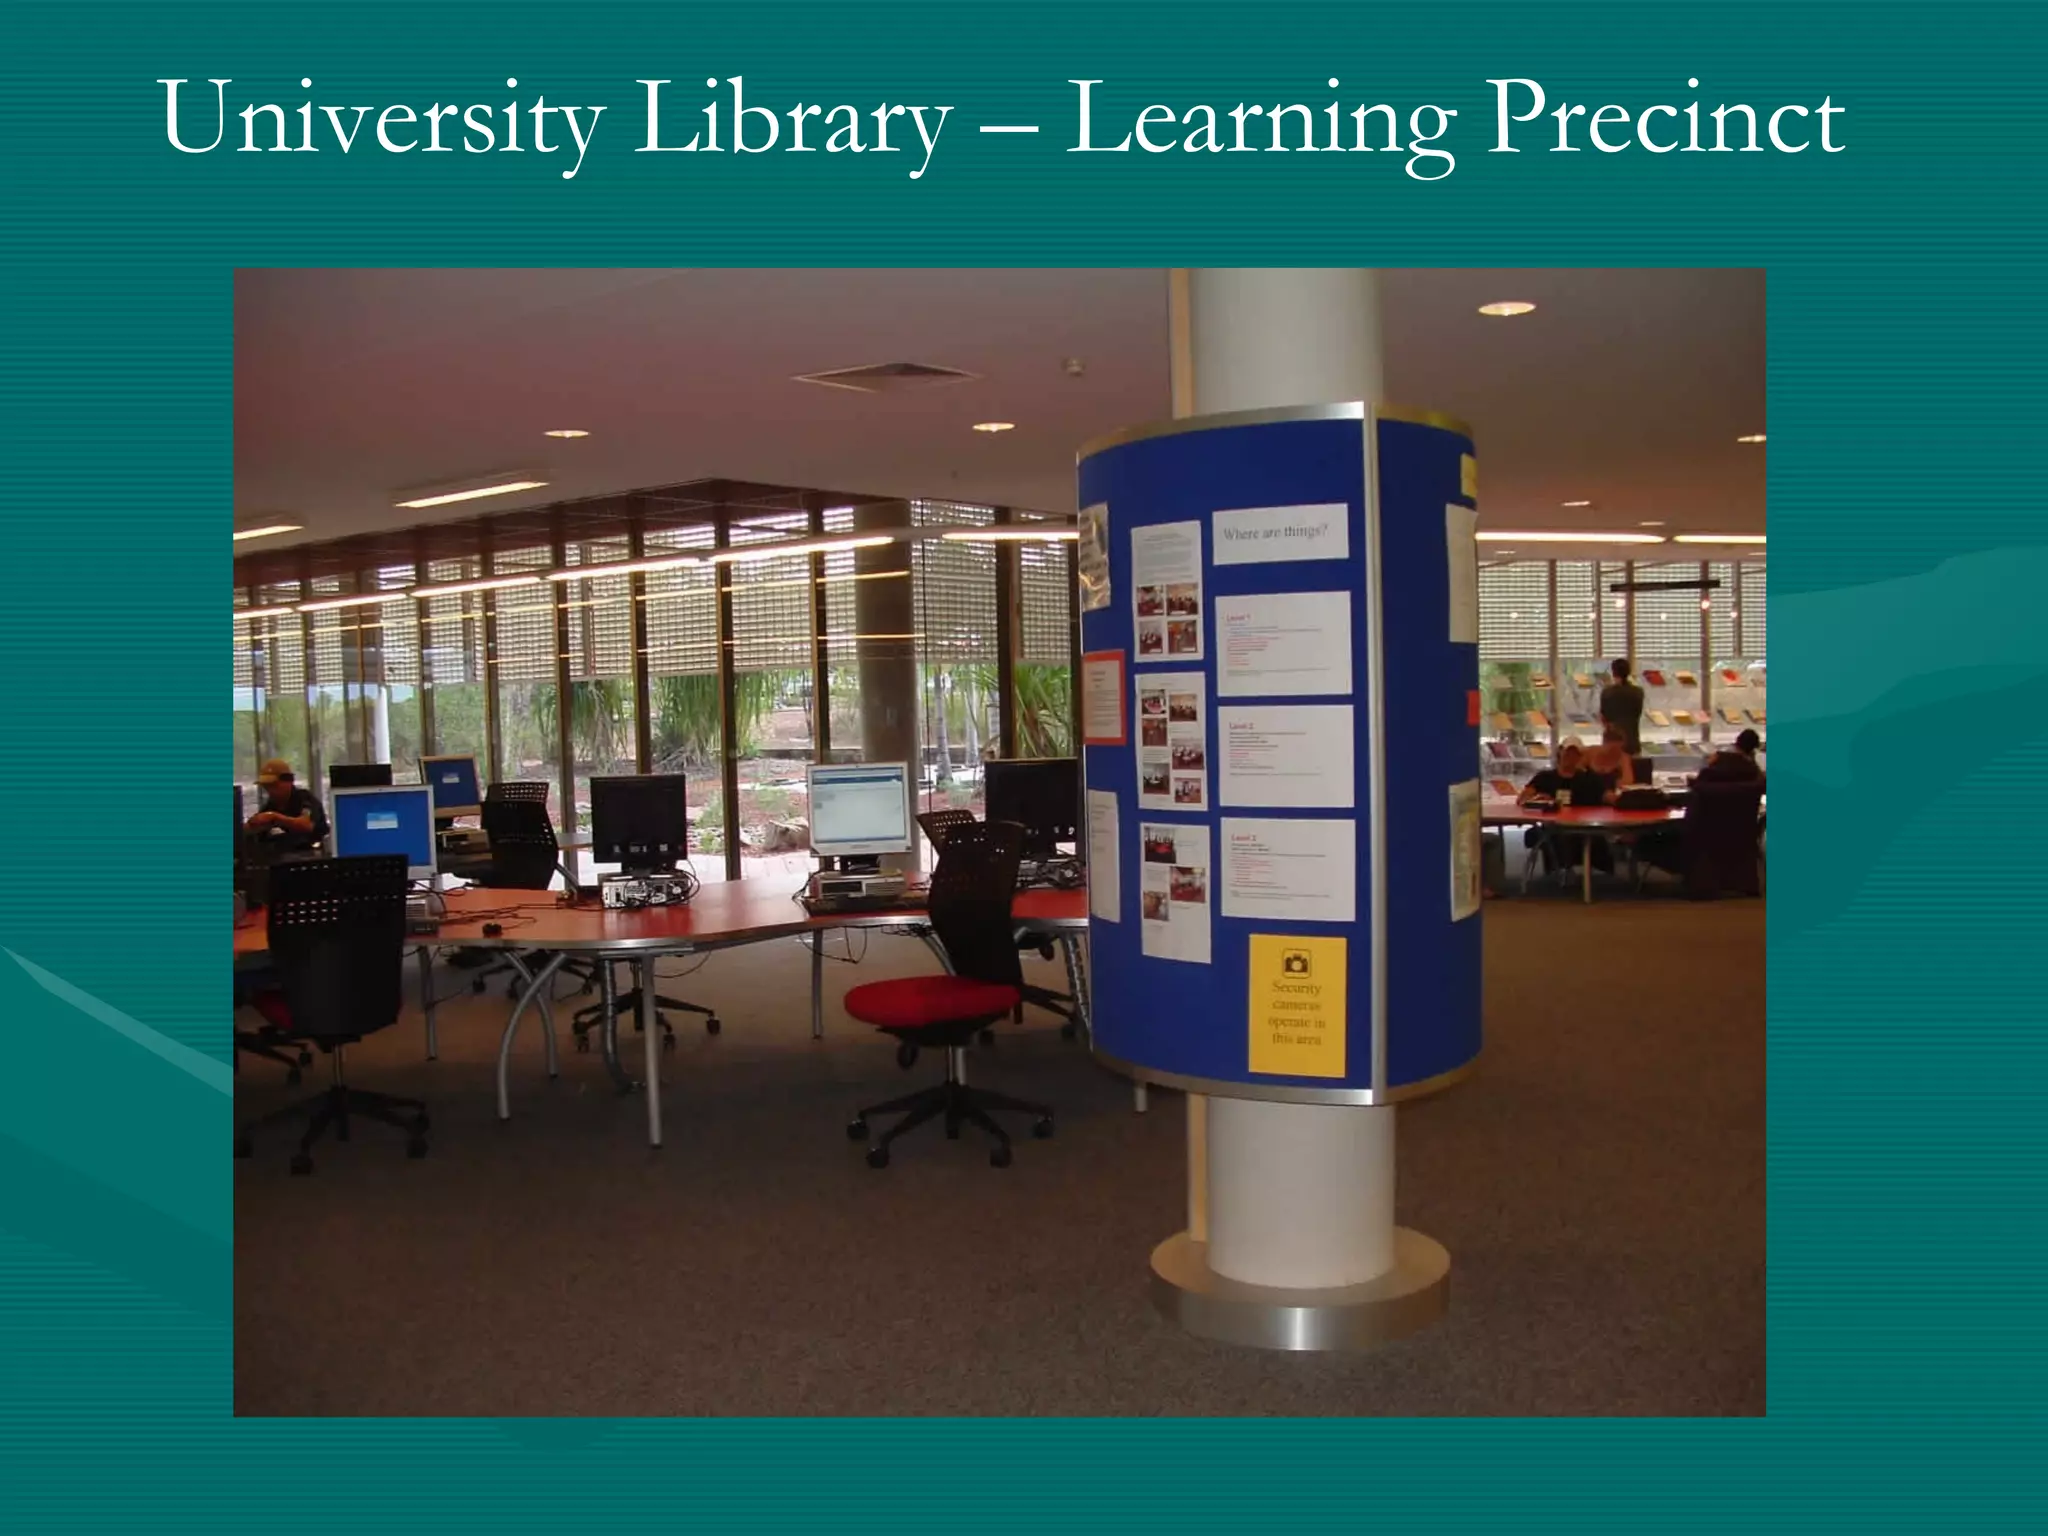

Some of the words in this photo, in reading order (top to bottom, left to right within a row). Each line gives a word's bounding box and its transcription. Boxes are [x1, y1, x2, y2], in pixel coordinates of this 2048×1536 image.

[1223, 526, 1259, 541] Where
[1261, 527, 1281, 540] are
[1284, 522, 1329, 540] things?
[1271, 981, 1322, 996] Security
[1271, 1000, 1321, 1011] cameras
[1268, 1017, 1311, 1029] operate
[1314, 1018, 1326, 1029] in
[1272, 1032, 1293, 1044] this
[1296, 1035, 1322, 1046] area
